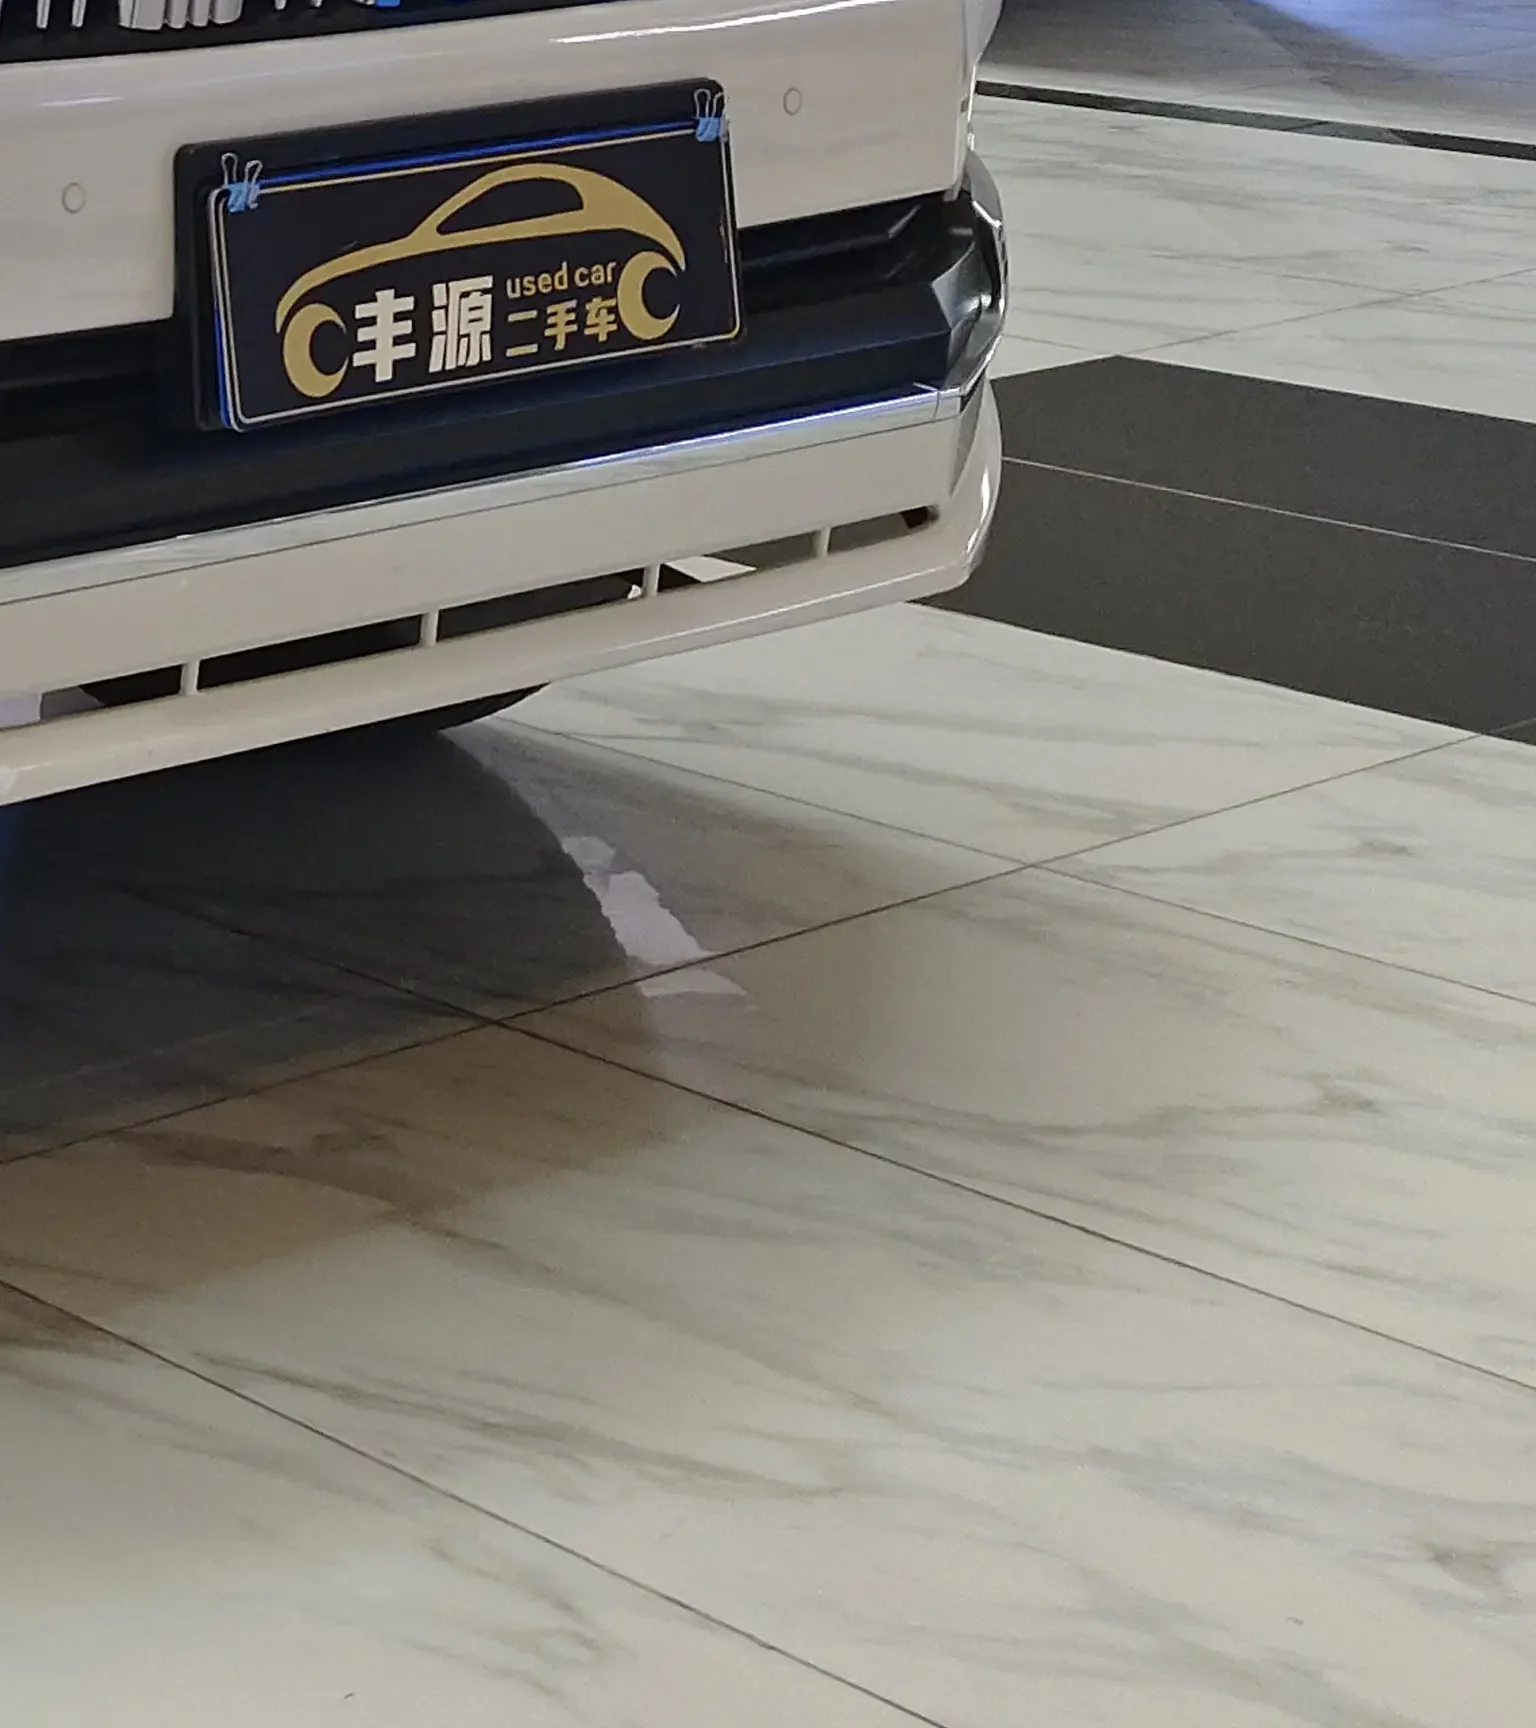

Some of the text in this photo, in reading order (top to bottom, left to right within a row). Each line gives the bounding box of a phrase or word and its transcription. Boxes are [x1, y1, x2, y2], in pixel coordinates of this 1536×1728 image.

[505, 260, 618, 299] used car
[352, 274, 494, 383] 丰源
[505, 295, 619, 358] 二手车
